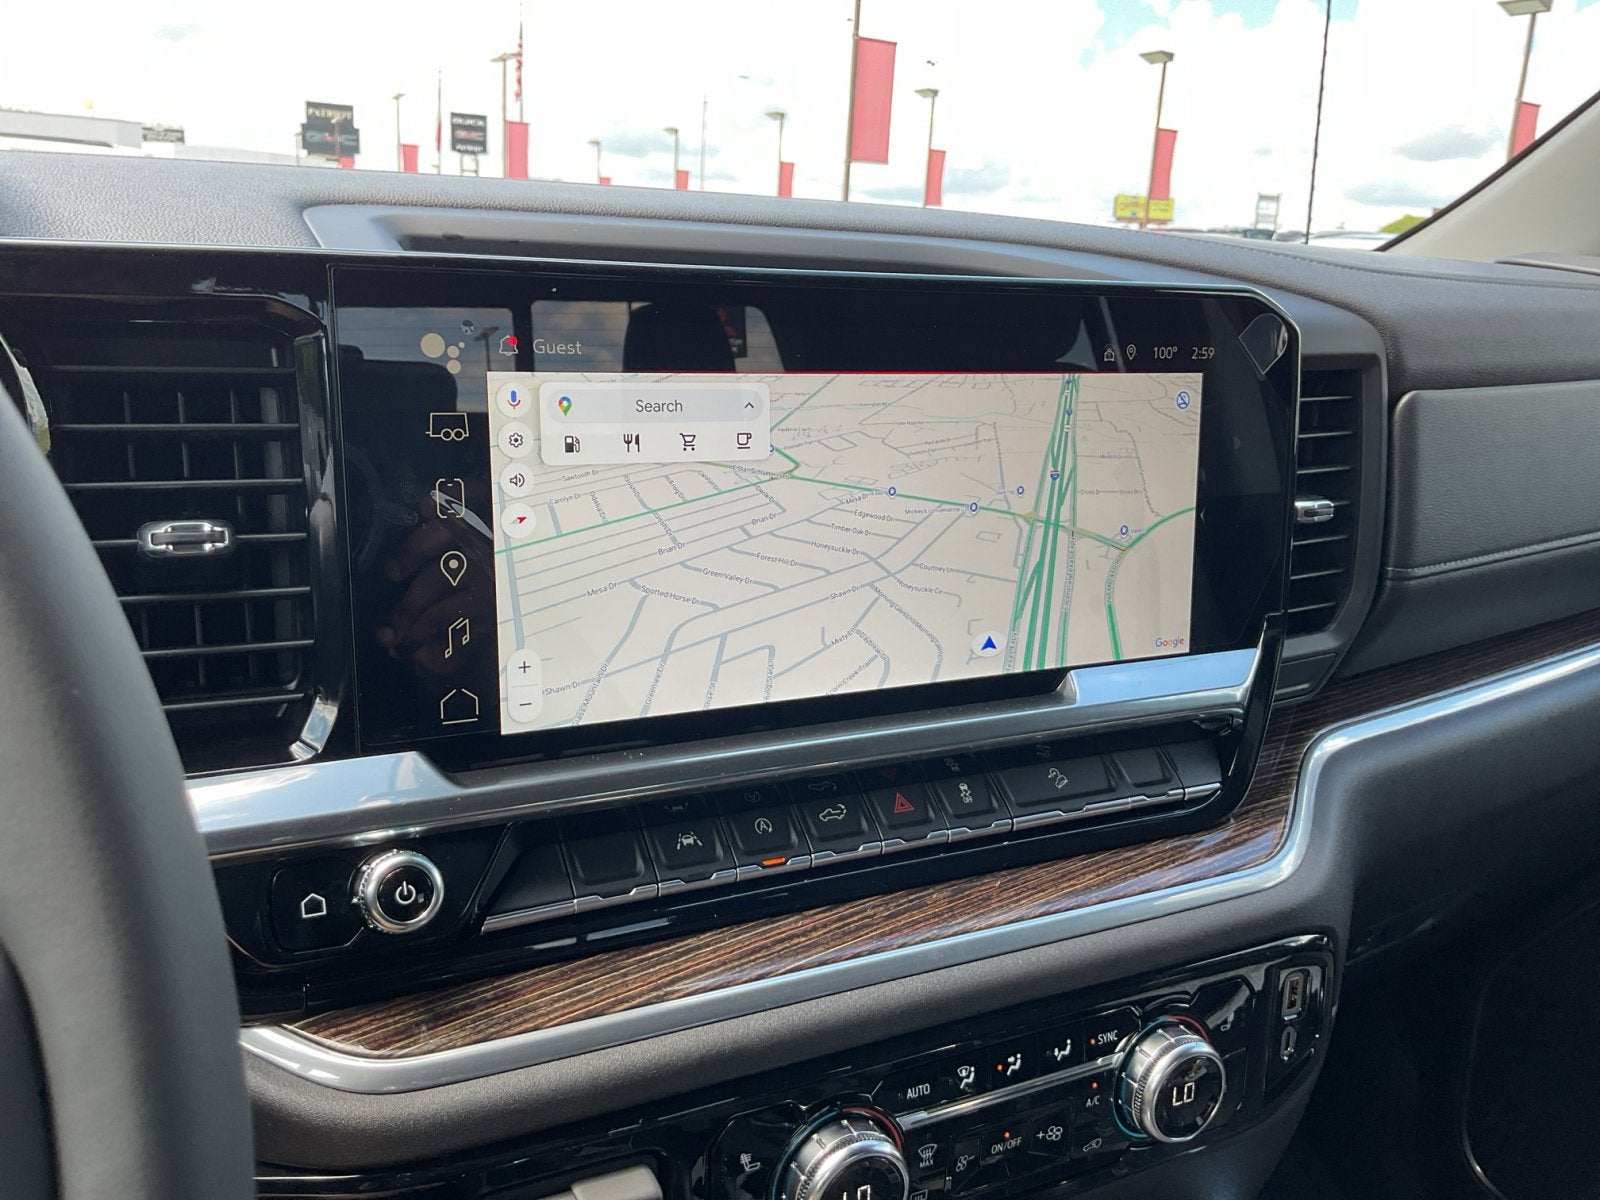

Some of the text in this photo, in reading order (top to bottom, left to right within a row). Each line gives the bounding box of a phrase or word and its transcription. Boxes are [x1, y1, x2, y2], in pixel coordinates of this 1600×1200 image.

[533, 339, 582, 354] Guest
[1191, 347, 1215, 360] 2:59
[635, 399, 683, 413] Search
[549, 494, 574, 504] Carolyn
[751, 512, 777, 525] Brian Dr
[854, 509, 885, 521] Edgewood
[831, 523, 851, 533] Timber
[852, 526, 863, 535] Oak
[657, 541, 685, 556] Brian Dr
[811, 540, 860, 556] Honeysuckle Dr
[756, 552, 798, 567] Forest Hill Dr
[703, 567, 753, 585] Green Valley Dr
[587, 585, 608, 597] Mesa
[641, 585, 700, 605] Spotted Horse Dr
[830, 588, 850, 600] Shawn
[831, 635, 848, 646] Misty
[1155, 636, 1185, 648] Google
[657, 663, 664, 673] Dr
[545, 684, 571, 695] Shawn
[584, 672, 605, 707] Mountain
[600, 663, 608, 673] Dr
[1098, 1030, 1118, 1045] SYNC
[906, 1084, 931, 1100] AUTO
[1172, 1082, 1195, 1107] LO
[1086, 1095, 1100, 1108] A/C
[992, 1137, 1022, 1154] ON/OFF
[920, 1159, 934, 1168] MAX
